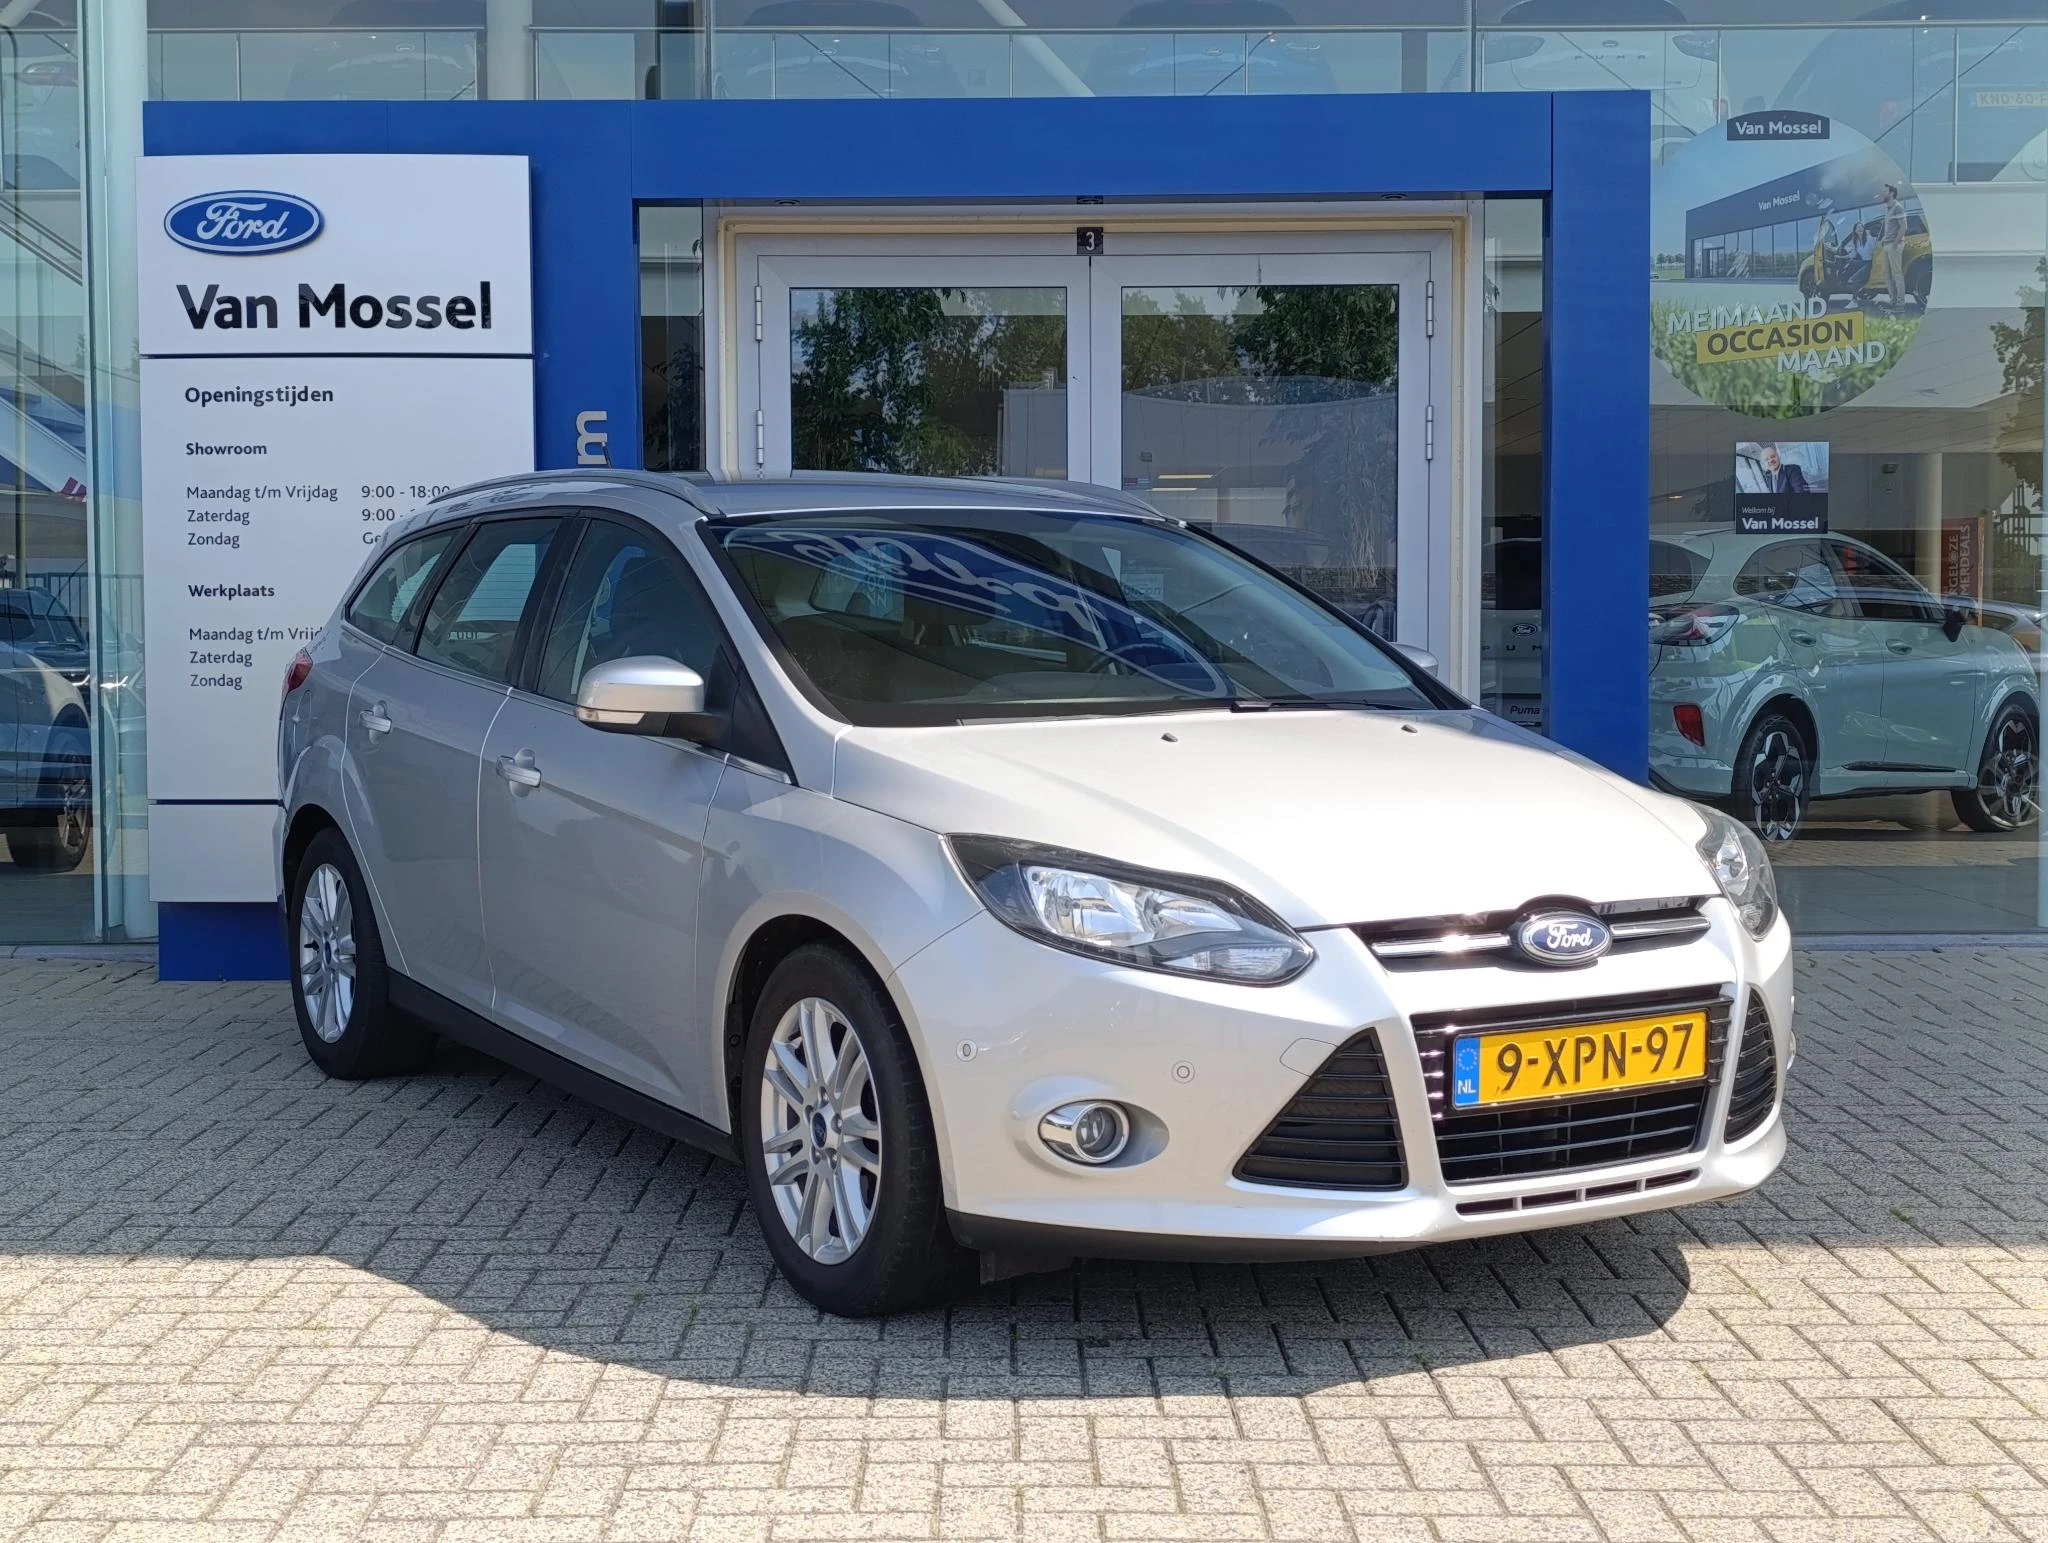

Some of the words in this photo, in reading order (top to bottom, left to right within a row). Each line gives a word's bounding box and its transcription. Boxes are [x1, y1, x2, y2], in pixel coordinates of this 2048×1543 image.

[1735, 121, 1764, 135] Van
[1768, 119, 1822, 134] Mossel
[1758, 201, 1772, 211] Van
[1773, 189, 1801, 207] Mossel
[196, 200, 290, 240] Ford
[1086, 231, 1095, 251] 3
[176, 283, 278, 329] Van
[298, 280, 492, 329] Mossel
[1667, 297, 1828, 335] MEIMAAND
[1707, 319, 1854, 356] OCCASION
[1777, 341, 1887, 373] MAAND
[185, 385, 334, 408] Openingstijden
[186, 442, 268, 456] Showroom
[186, 485, 251, 503] Maandag
[255, 485, 282, 499] t/m
[286, 485, 339, 502] Vrijdag
[361, 485, 395, 498] 9:00
[187, 508, 251, 526] Zaterdag
[361, 508, 396, 521] 9:00
[1742, 506, 1767, 514] Welkom
[1767, 506, 1777, 516] bij
[1742, 517, 1768, 530] Van
[1771, 516, 1819, 529] Mossel
[187, 532, 241, 549] Zondag
[188, 584, 275, 600] Werkplaats
[189, 627, 254, 644] Maandag
[257, 627, 284, 641] t/m
[190, 650, 253, 667] Zaterdag
[190, 674, 243, 690] Zondag
[1510, 705, 1541, 715] Puma
[1546, 922, 1593, 949] Ford
[1497, 1022, 1694, 1092] 9-XPN-97
[1457, 1079, 1476, 1095] NL
